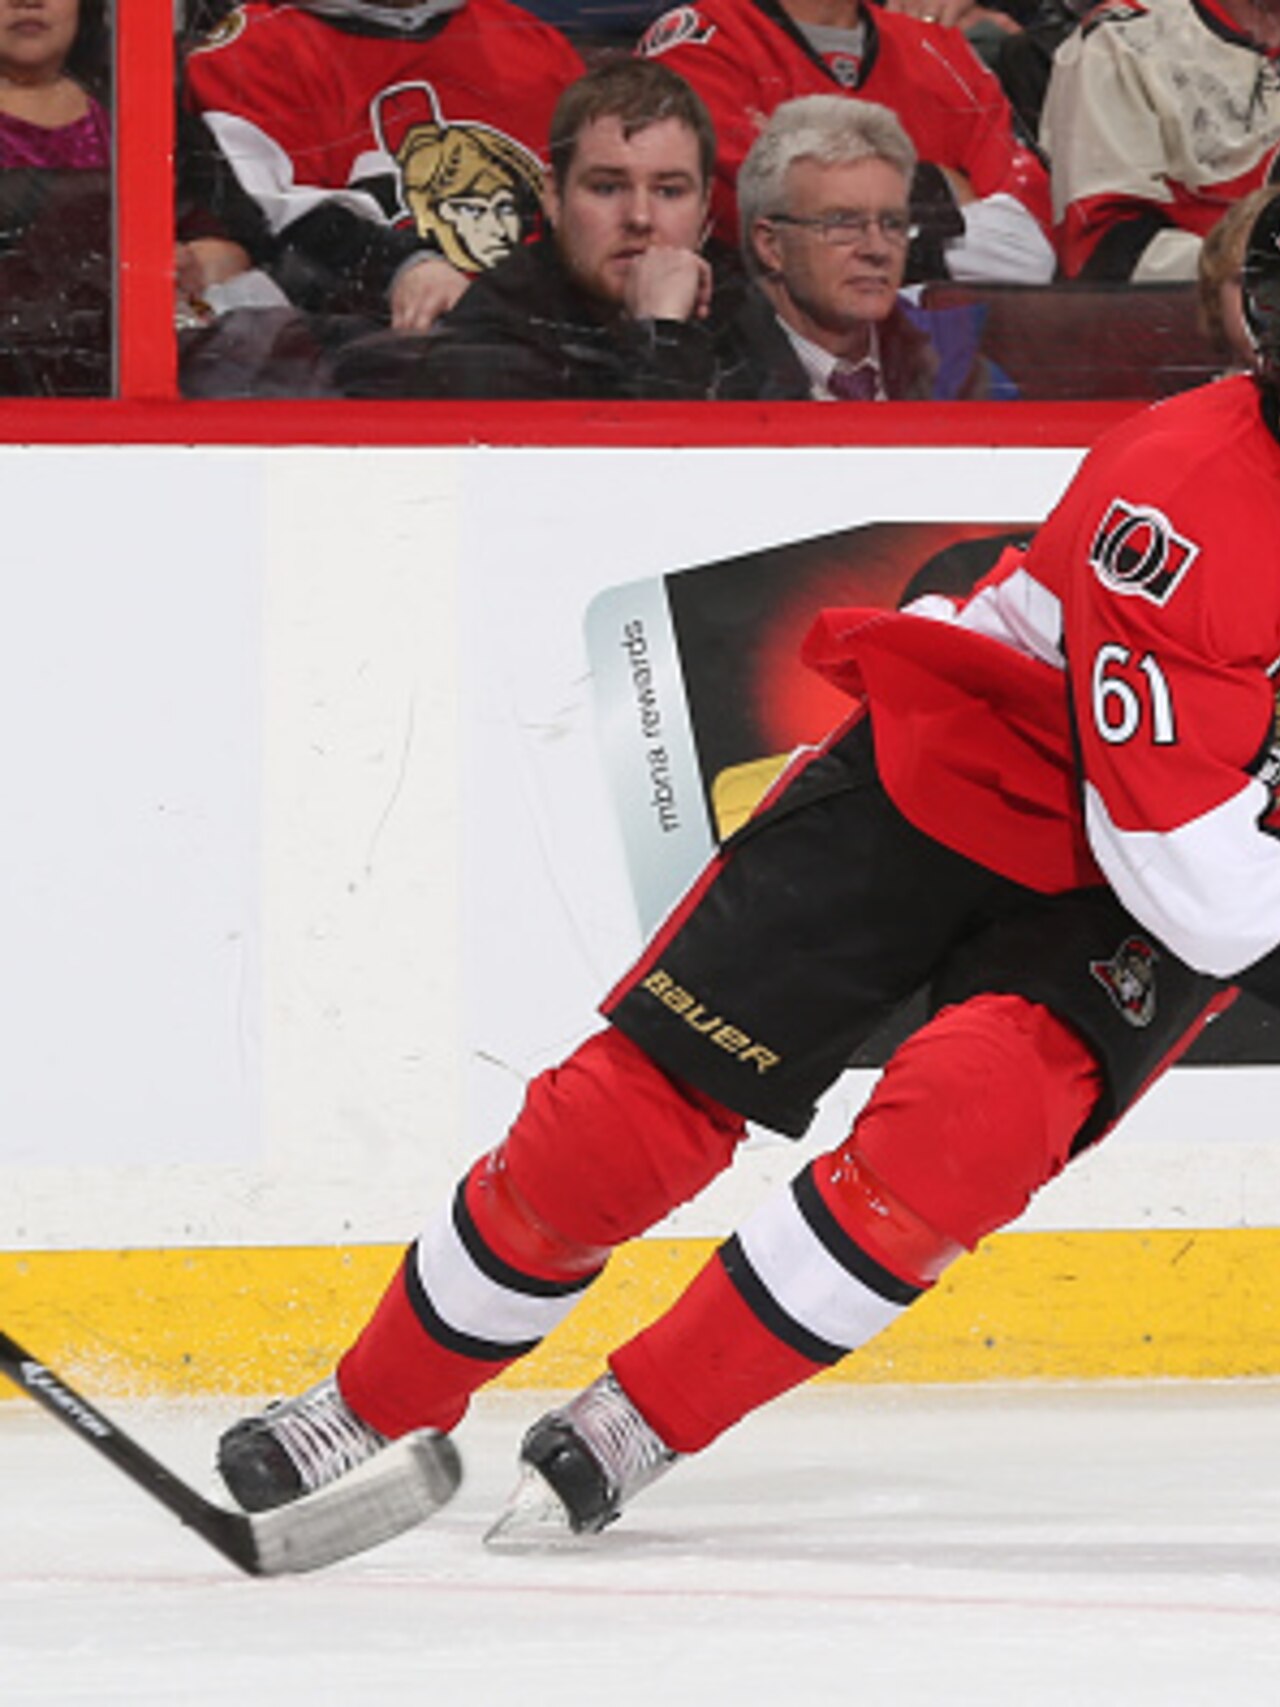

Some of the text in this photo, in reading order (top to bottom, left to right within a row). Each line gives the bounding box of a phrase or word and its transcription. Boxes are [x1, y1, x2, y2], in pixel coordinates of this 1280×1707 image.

[620, 619, 681, 833] mbna rewards
[1092, 642, 1178, 745] 61
[641, 969, 781, 1075] BAUER
